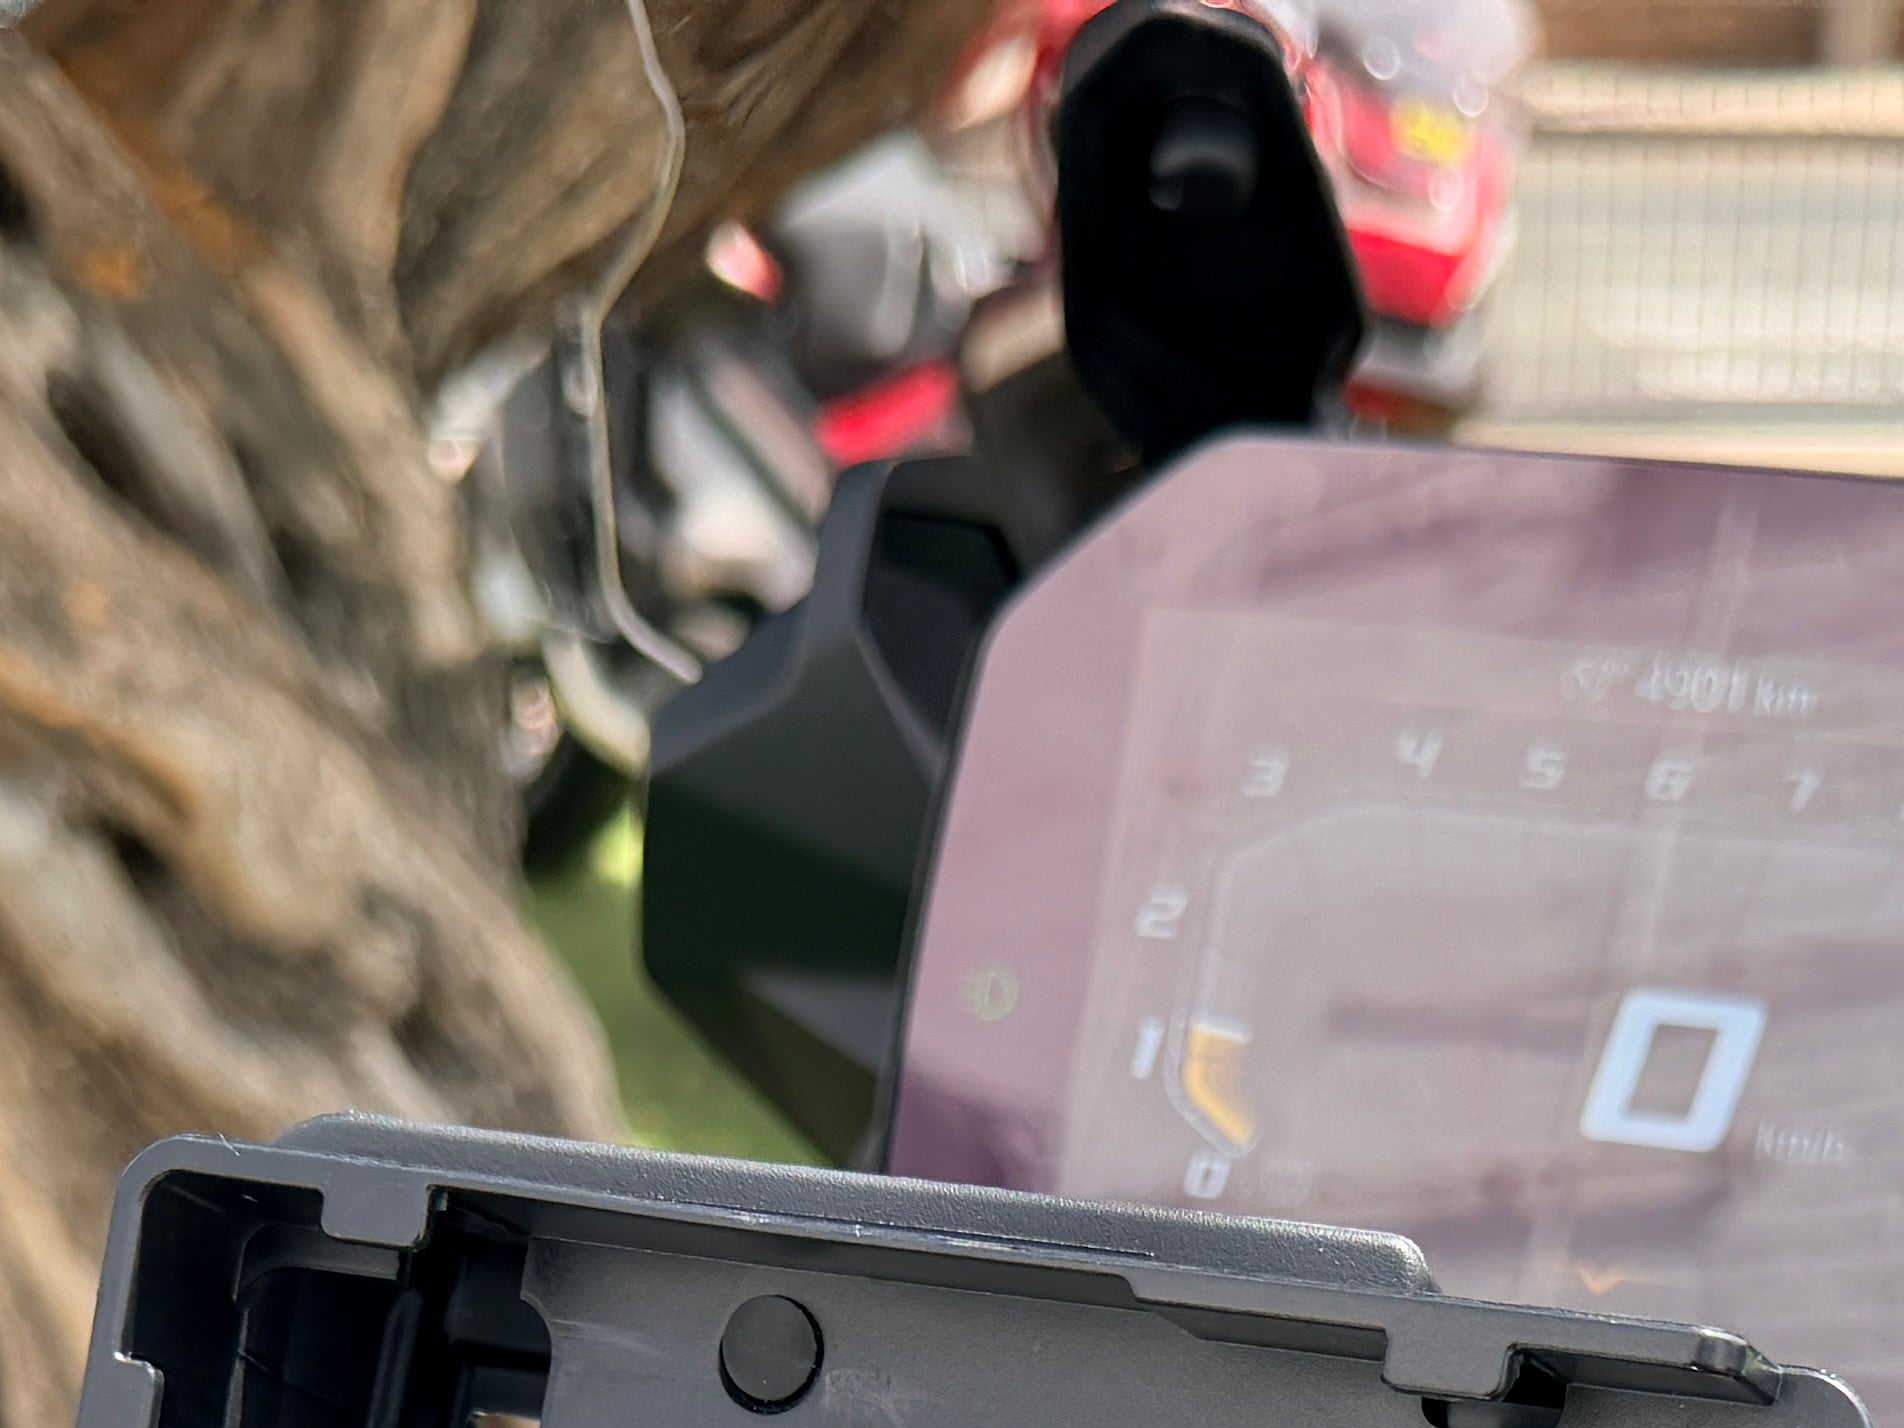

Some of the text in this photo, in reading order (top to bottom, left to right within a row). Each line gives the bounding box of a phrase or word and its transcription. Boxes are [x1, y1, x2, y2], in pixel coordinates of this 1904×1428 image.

[1243, 754, 1290, 797] 3
[1398, 731, 1443, 778] 4
[1522, 746, 1568, 791] 5
[1645, 757, 1695, 801] 6
[1783, 768, 1824, 812] 7
[1135, 891, 1189, 939] 2
[1130, 1016, 1165, 1080] 1
[1581, 987, 1768, 1152] 0
[1184, 1152, 1233, 1200] 0
